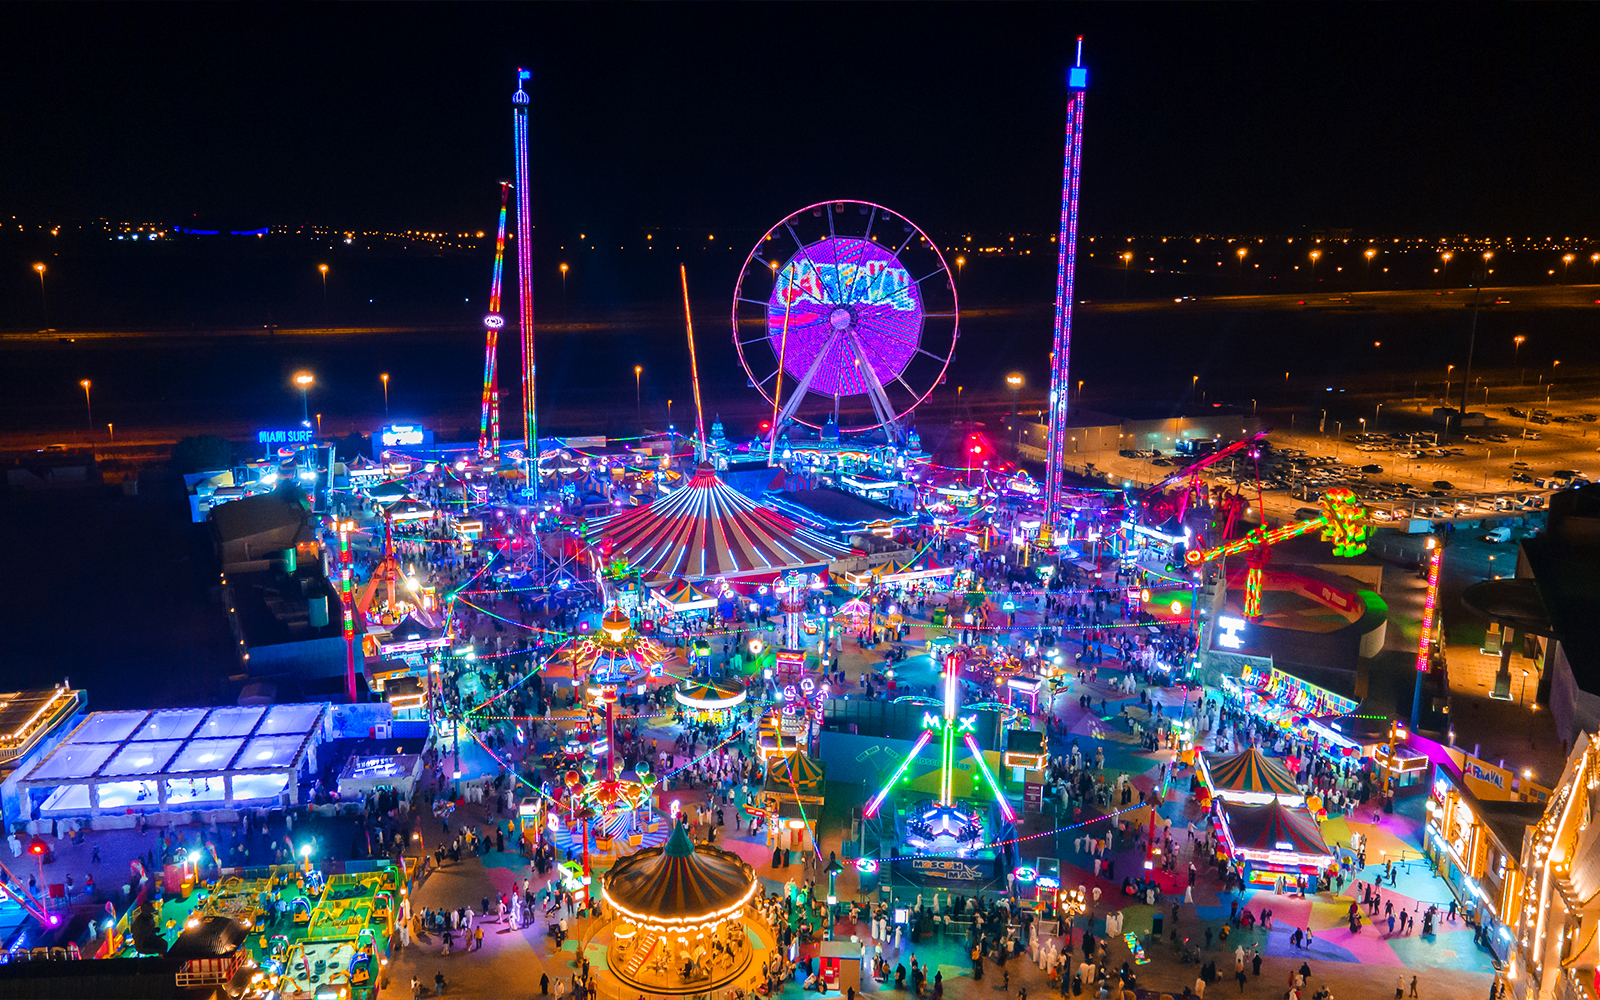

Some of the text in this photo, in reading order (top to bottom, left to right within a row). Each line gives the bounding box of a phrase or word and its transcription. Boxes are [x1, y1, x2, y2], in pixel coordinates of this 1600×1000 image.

[259, 430, 313, 443] MIAMI SURF
[923, 710, 977, 732] MX
